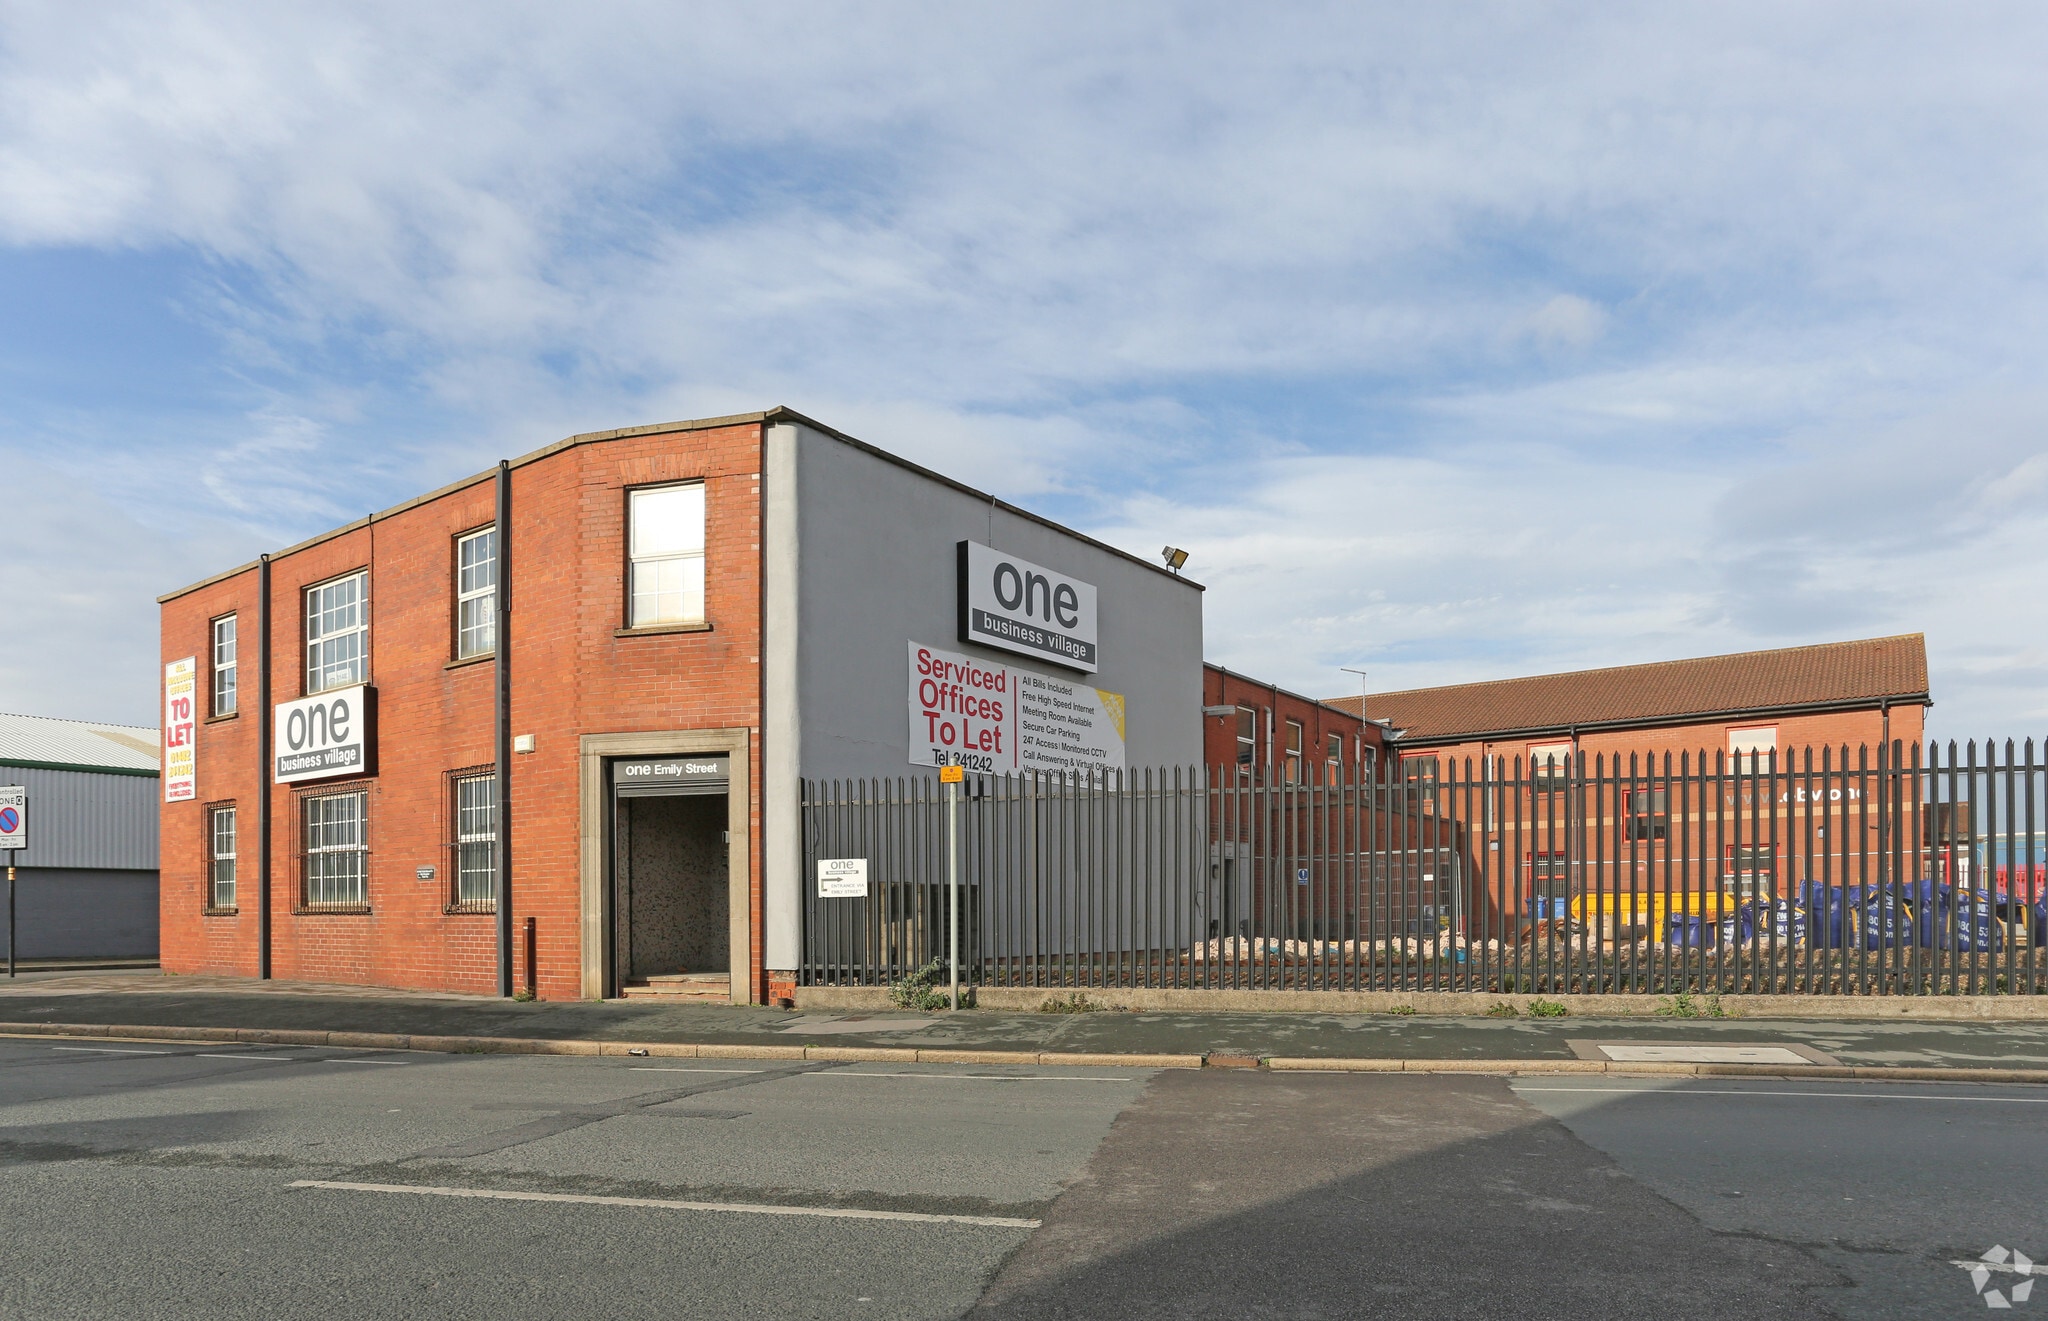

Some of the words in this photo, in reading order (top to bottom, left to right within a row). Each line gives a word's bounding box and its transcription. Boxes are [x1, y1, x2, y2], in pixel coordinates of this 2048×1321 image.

[993, 562, 1079, 630] one
[983, 612, 1043, 645] business
[1048, 634, 1087, 659] village
[917, 648, 1006, 693] Serviced
[1022, 676, 1031, 686] All
[1032, 678, 1046, 690] Bills
[1047, 681, 1073, 696] Included
[170, 696, 190, 721] TO
[919, 678, 1004, 722] Offices
[1022, 690, 1036, 702] Free
[1037, 693, 1052, 707] High
[1053, 697, 1072, 710] Speed
[1073, 702, 1095, 715] Internet
[287, 698, 350, 751] one
[1022, 704, 1047, 721] Meeting
[1048, 711, 1067, 723] Room
[1067, 715, 1093, 728] Available
[167, 722, 193, 748] LET
[922, 710, 956, 746] To
[963, 718, 1002, 754] Let
[1022, 720, 1045, 733] Secure
[1046, 725, 1057, 735] Car
[1058, 728, 1081, 742] Parking
[1023, 749, 1035, 760] Call
[1036, 752, 1069, 767] Answering
[1069, 758, 1075, 767] &
[1076, 758, 1095, 770] Virtual
[1035, 737, 1058, 750] Access
[1061, 742, 1090, 756] Monitored
[1091, 748, 1107, 758] CCTV
[281, 754, 322, 772] business
[324, 748, 357, 765] village
[625, 764, 651, 776] one
[654, 763, 683, 777] Emily
[685, 762, 718, 774] Street
[953, 752, 993, 773] 241242
[1023, 764, 1047, 777] Vaous
[0, 787, 23, 795] ntrolled
[0, 797, 15, 805] ONE
[830, 860, 854, 870] one
